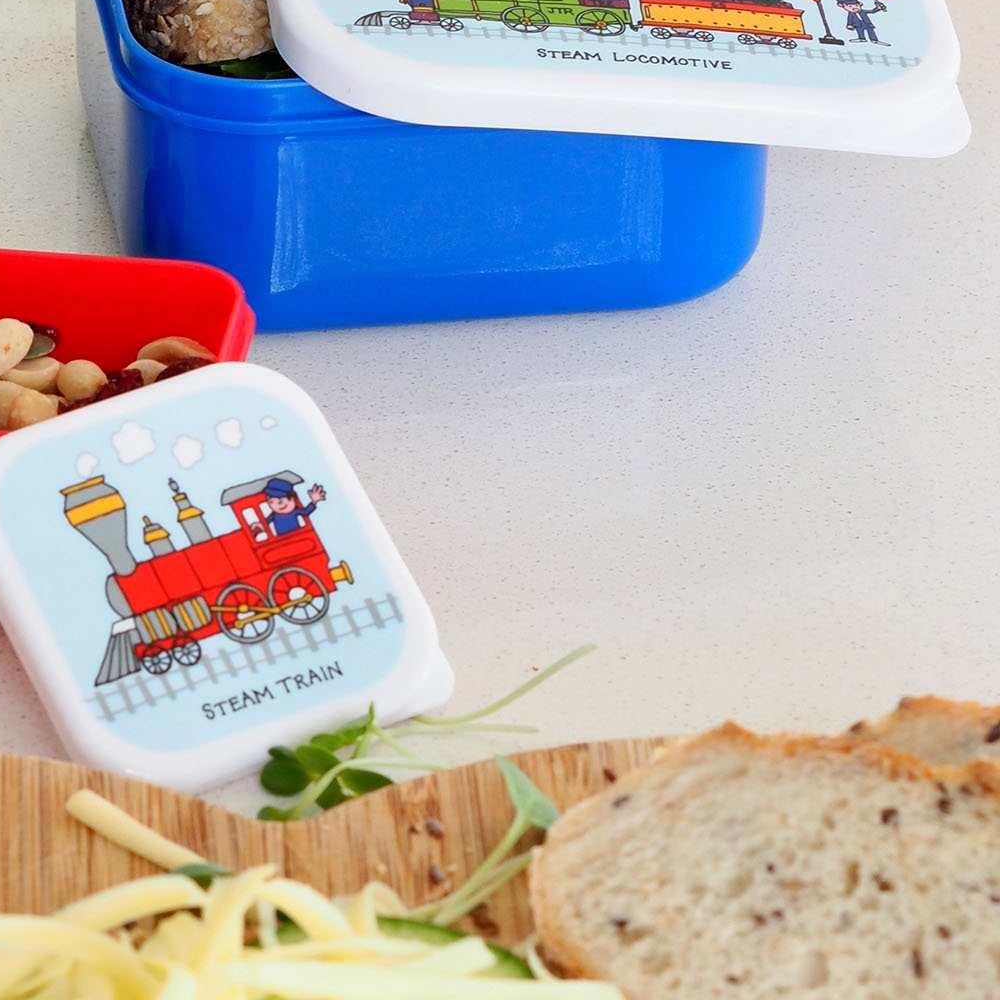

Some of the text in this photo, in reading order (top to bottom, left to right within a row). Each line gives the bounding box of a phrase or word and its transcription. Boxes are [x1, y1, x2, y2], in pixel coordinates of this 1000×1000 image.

[548, 6, 576, 17] JTR
[536, 48, 733, 71] STEAM LOCOMOTIVE
[201, 660, 344, 721] STEAM TRAIN
